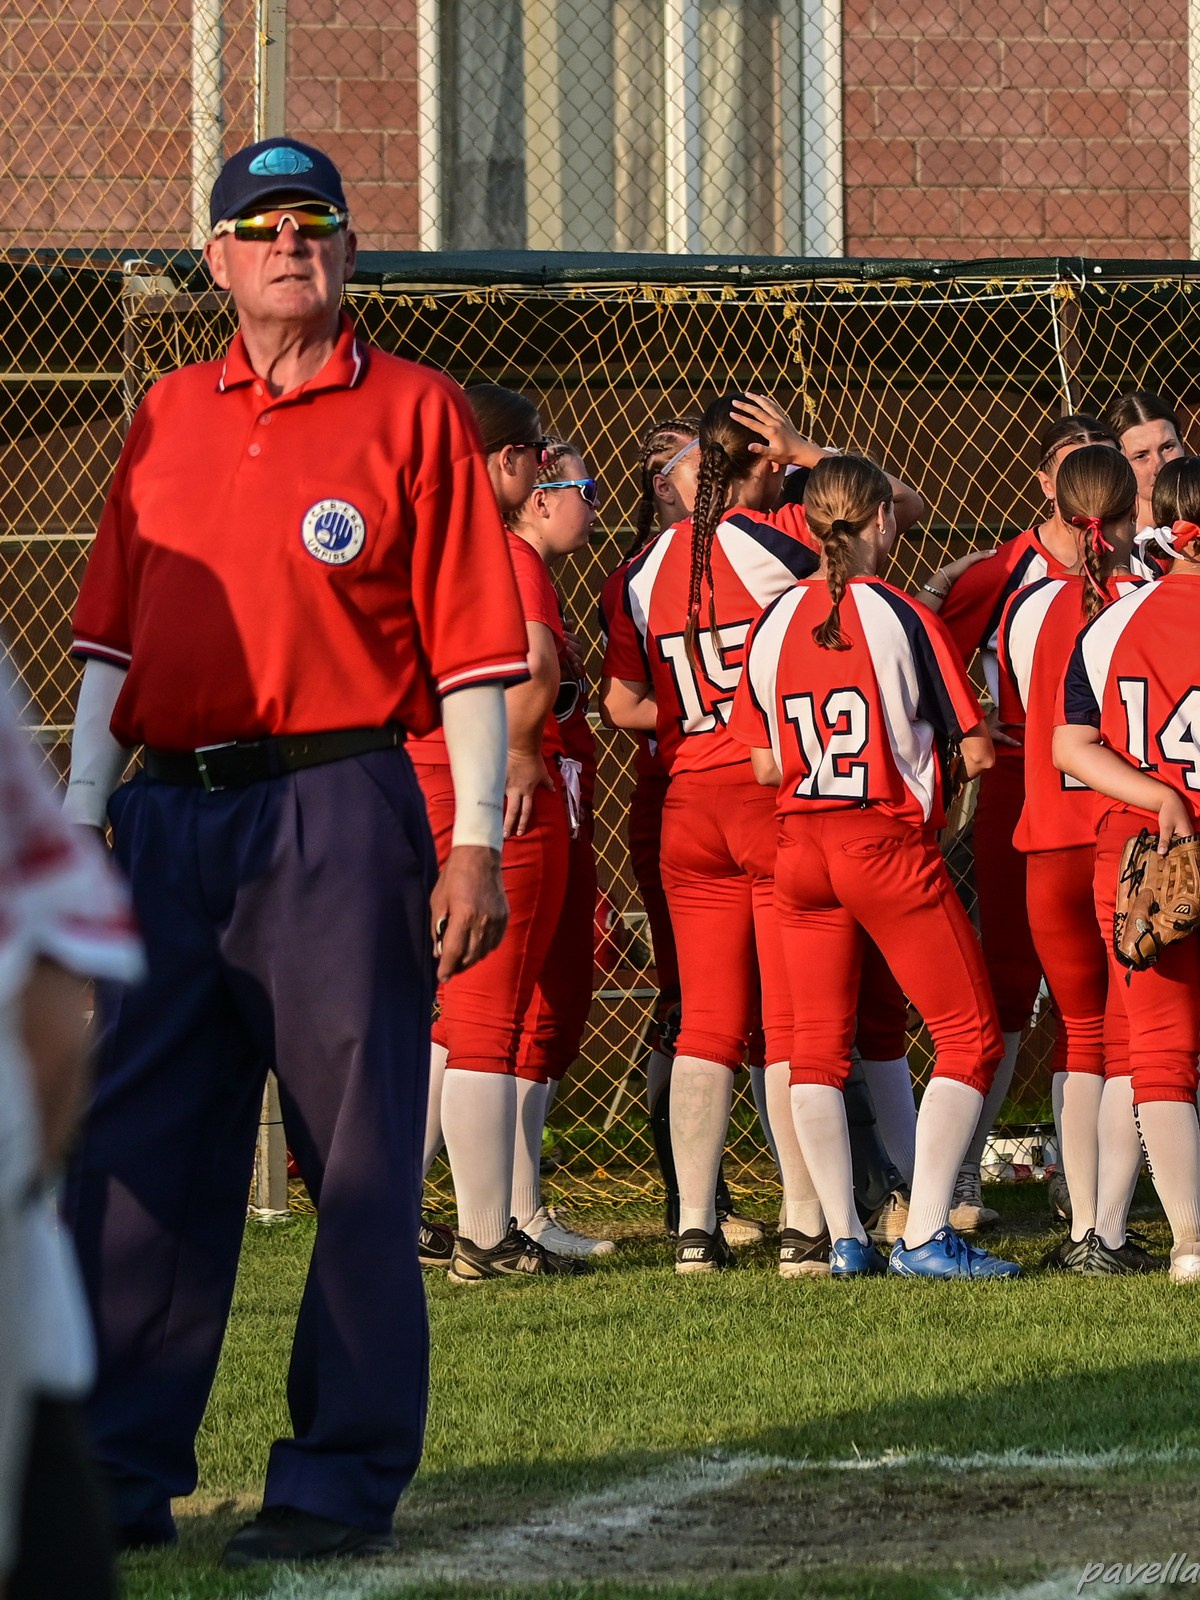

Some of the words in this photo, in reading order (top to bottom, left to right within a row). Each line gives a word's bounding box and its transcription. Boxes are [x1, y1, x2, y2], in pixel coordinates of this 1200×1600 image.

[298, 540, 345, 560] UMPIRE
[655, 618, 754, 736] 15
[782, 686, 869, 800] 12
[681, 1247, 706, 1260] NIKE
[780, 1247, 796, 1259] IKE
[515, 1255, 539, 1273] N
